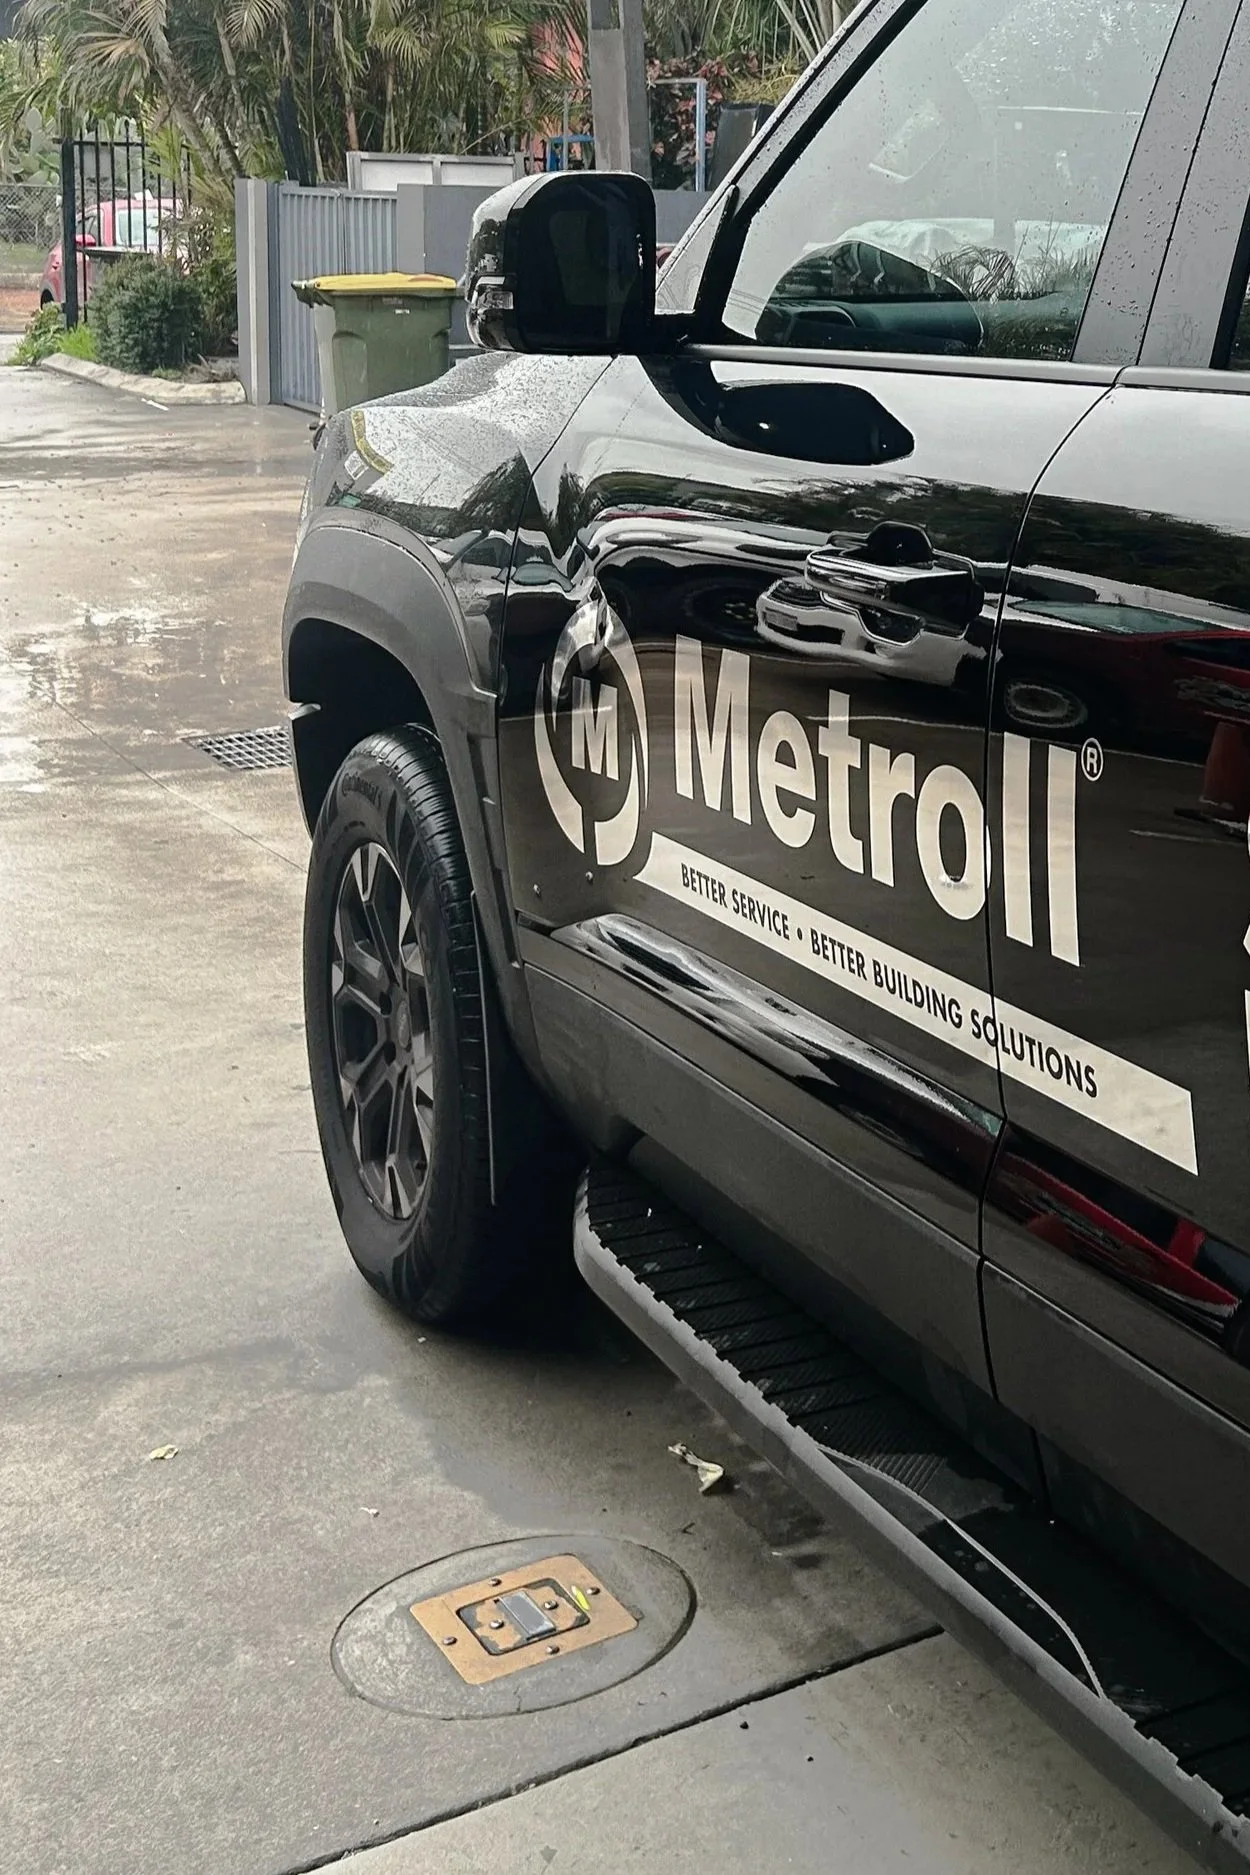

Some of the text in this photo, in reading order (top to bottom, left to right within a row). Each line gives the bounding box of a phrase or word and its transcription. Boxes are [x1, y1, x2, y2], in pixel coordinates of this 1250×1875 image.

[571, 675, 619, 781] M
[681, 863, 1097, 1098] BETTER SERVICE BETTER BUILDING SOLUTIONS
